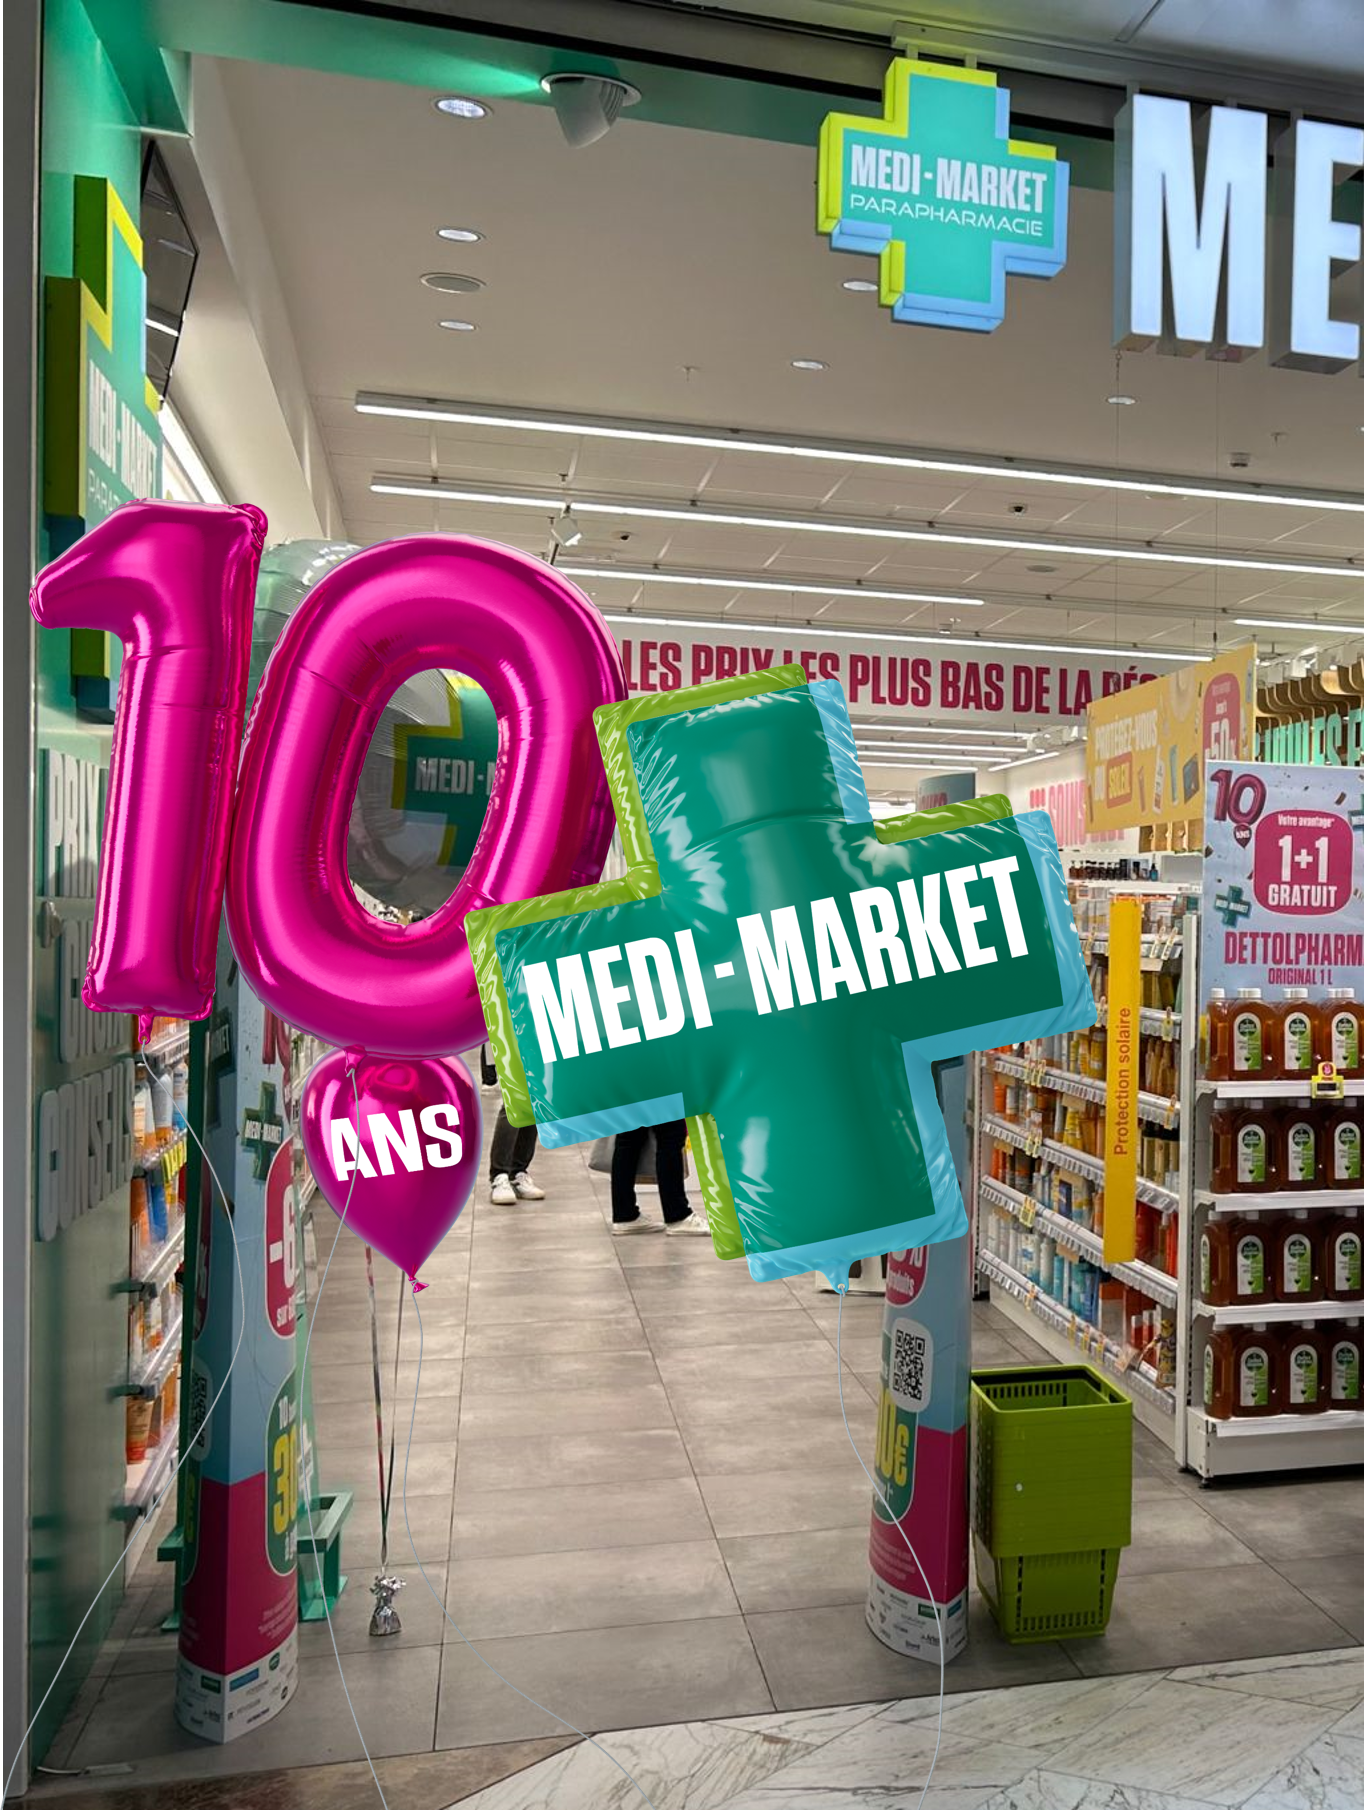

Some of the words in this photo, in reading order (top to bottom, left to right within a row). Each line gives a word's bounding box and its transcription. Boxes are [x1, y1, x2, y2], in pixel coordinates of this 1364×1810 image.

[851, 144, 1048, 214] MEDI-MARKET
[850, 193, 1044, 236] PARAPHARMACIE
[622, 639, 682, 692] LES
[849, 651, 929, 706] PLUS
[940, 660, 1006, 712] BAS
[1013, 667, 1051, 716] DE
[1058, 670, 1089, 717] LA
[1210, 769, 1267, 826] 10
[1278, 814, 1298, 827] Votre
[1278, 835, 1329, 883] 1+1
[1268, 884, 1337, 907] GRATUIT
[1268, 968, 1318, 984] ORIGINAL
[1118, 1007, 1131, 1062] solaire
[1113, 1070, 1130, 1155] Protection
